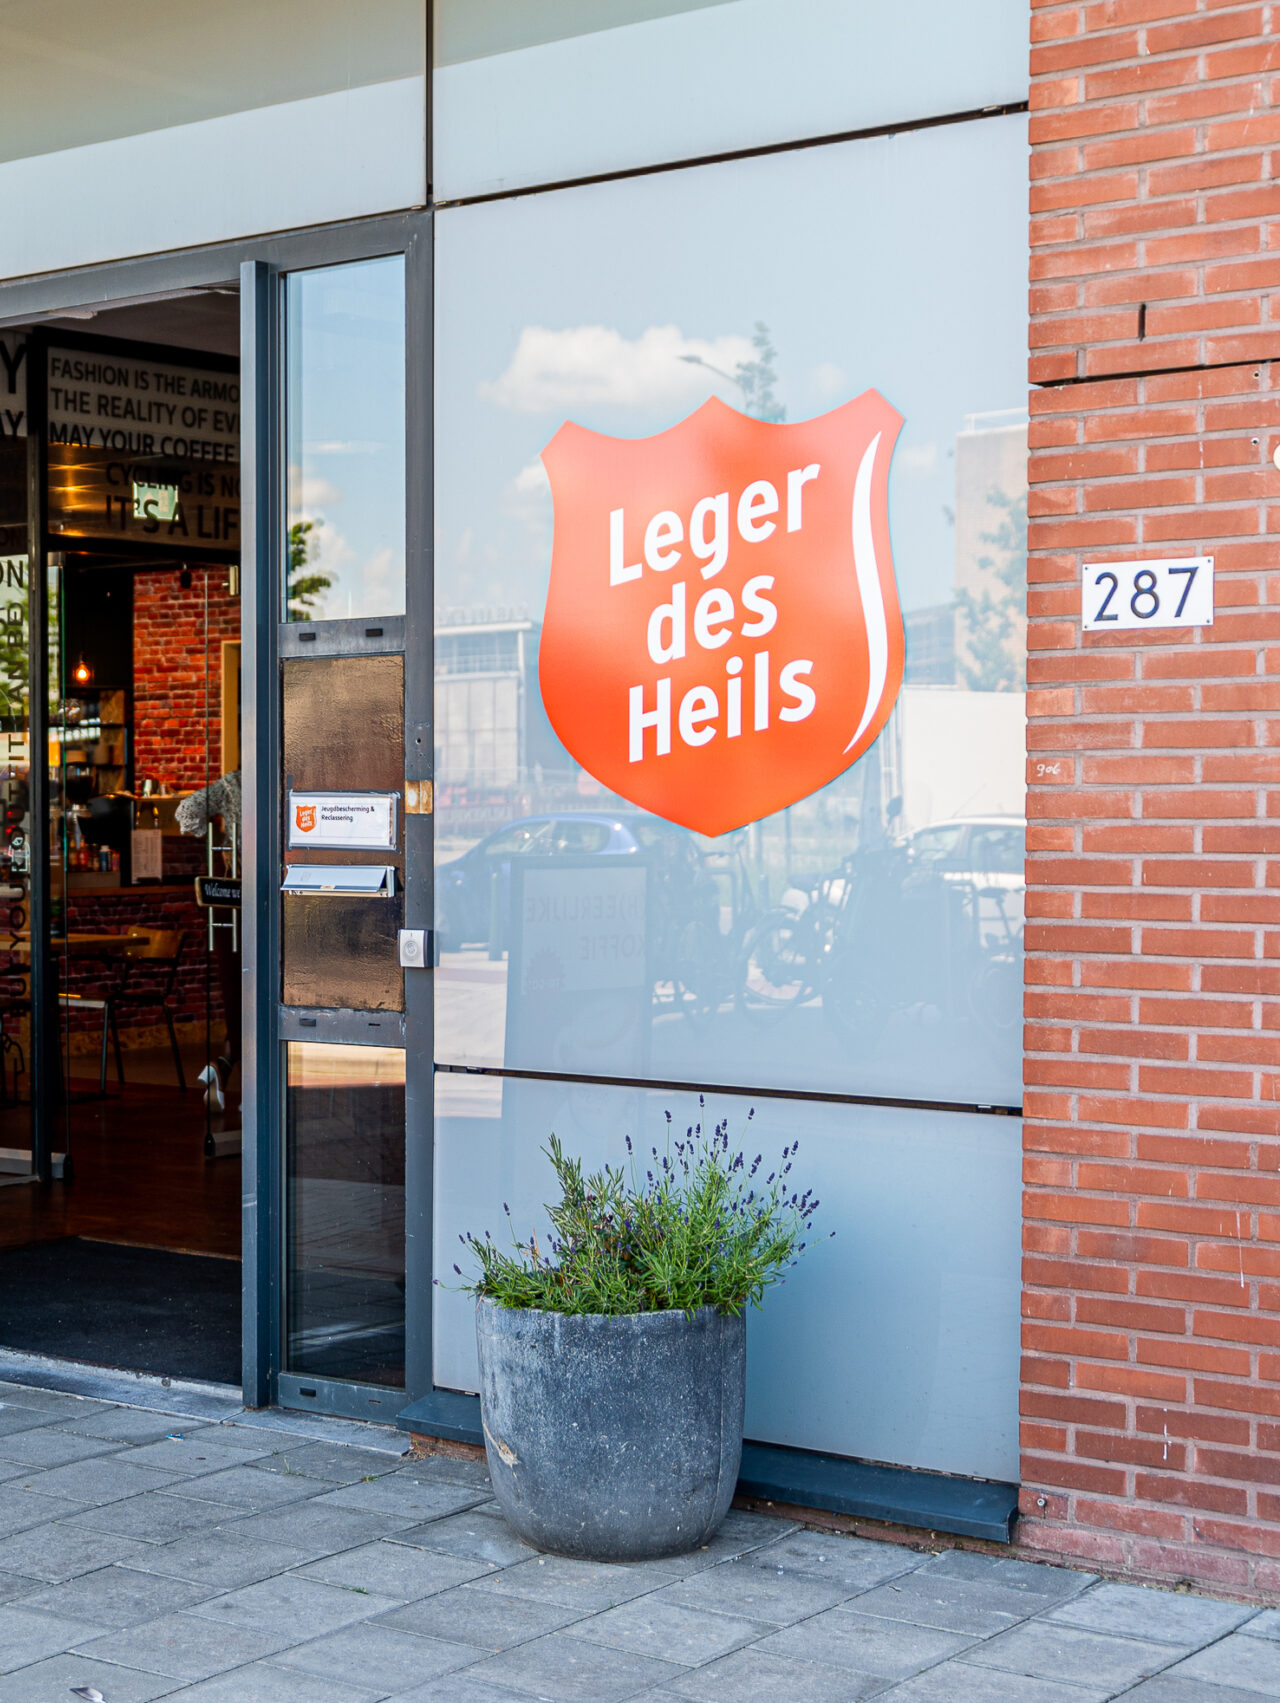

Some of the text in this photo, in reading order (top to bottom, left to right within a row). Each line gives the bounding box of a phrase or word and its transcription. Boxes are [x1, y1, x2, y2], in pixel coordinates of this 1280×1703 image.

[51, 358, 129, 387] FASHION
[135, 370, 149, 390] IS
[153, 373, 186, 396] THE
[50, 387, 240, 434] THE REALITY OF EV
[50, 422, 235, 465] MAY YOUR COFFEE
[106, 462, 192, 492] CYCLING
[198, 472, 215, 496] IS
[106, 495, 159, 533] IT'S
[168, 502, 189, 536] A
[609, 463, 821, 587] Leger
[1093, 566, 1199, 622] 287
[647, 575, 778, 665] des
[628, 651, 817, 764] Heils
[321, 814, 354, 822] Reclassering
